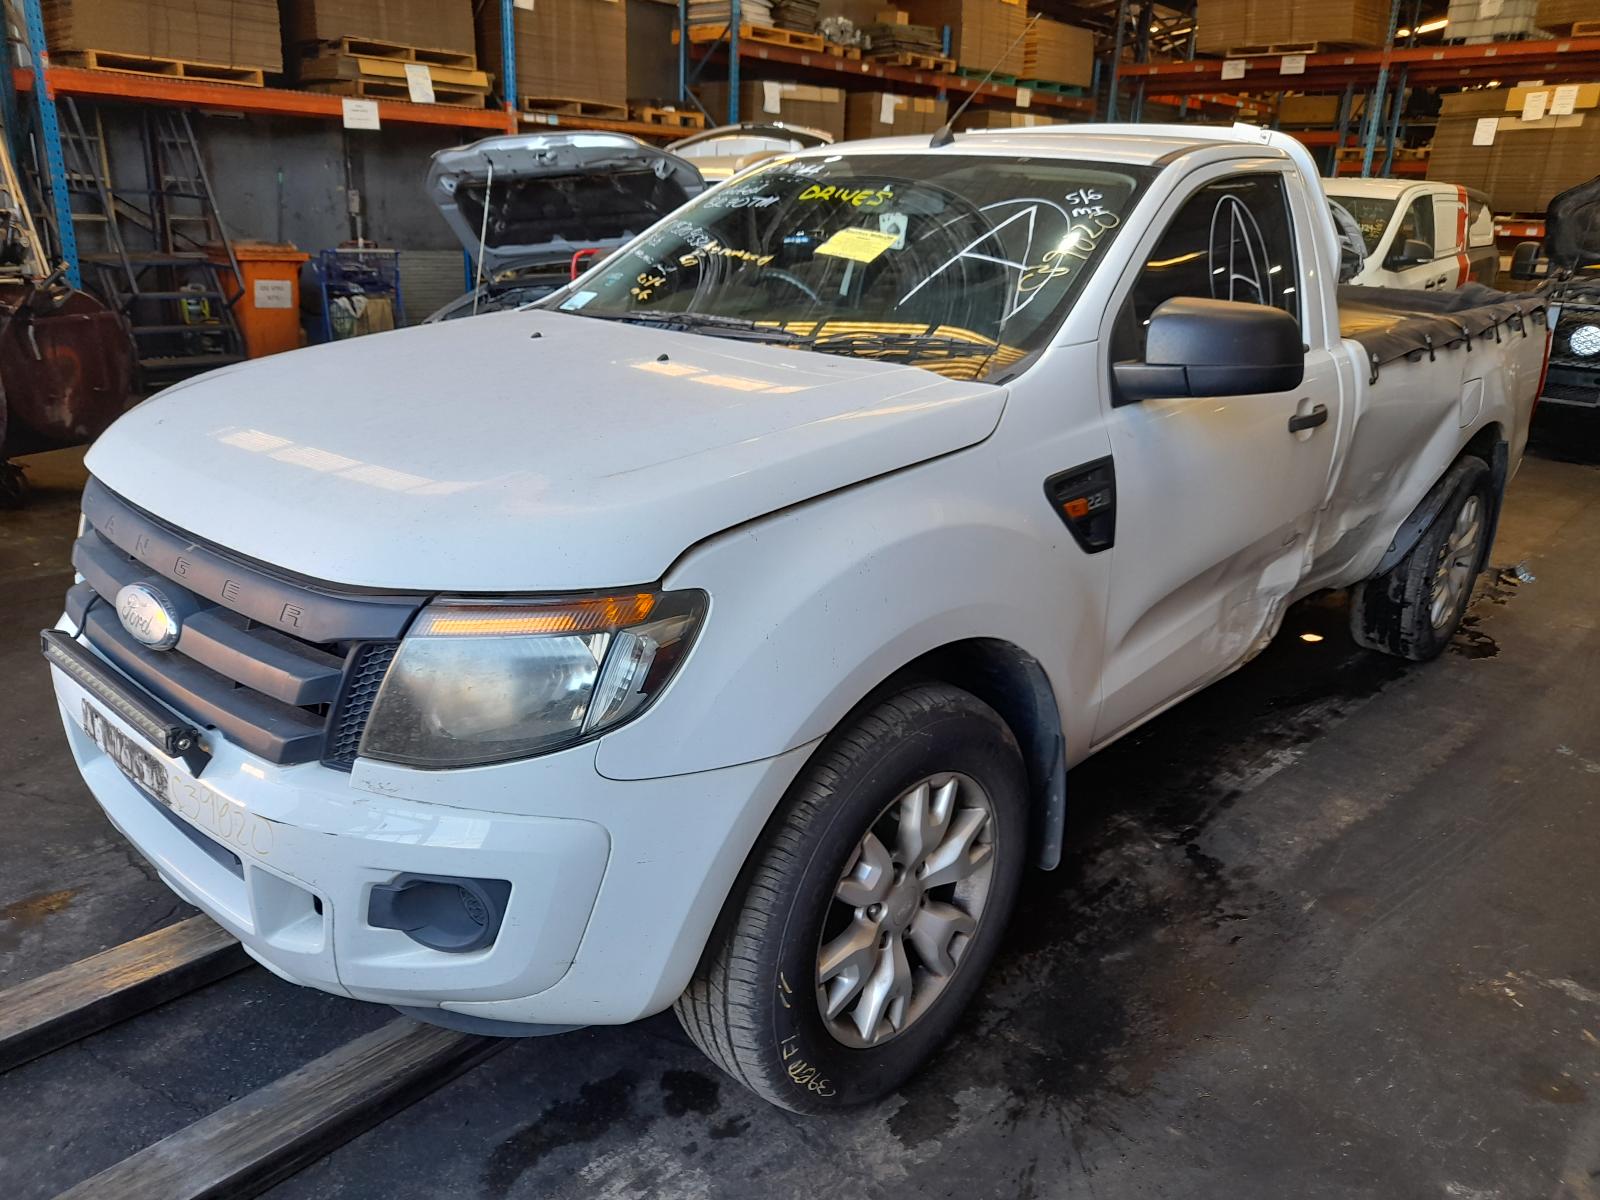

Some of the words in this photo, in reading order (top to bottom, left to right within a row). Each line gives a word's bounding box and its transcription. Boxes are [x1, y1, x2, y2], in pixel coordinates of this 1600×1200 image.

[798, 184, 894, 207] DRIVES
[88, 496, 304, 628] ANGER
[121, 593, 153, 636] Ford
